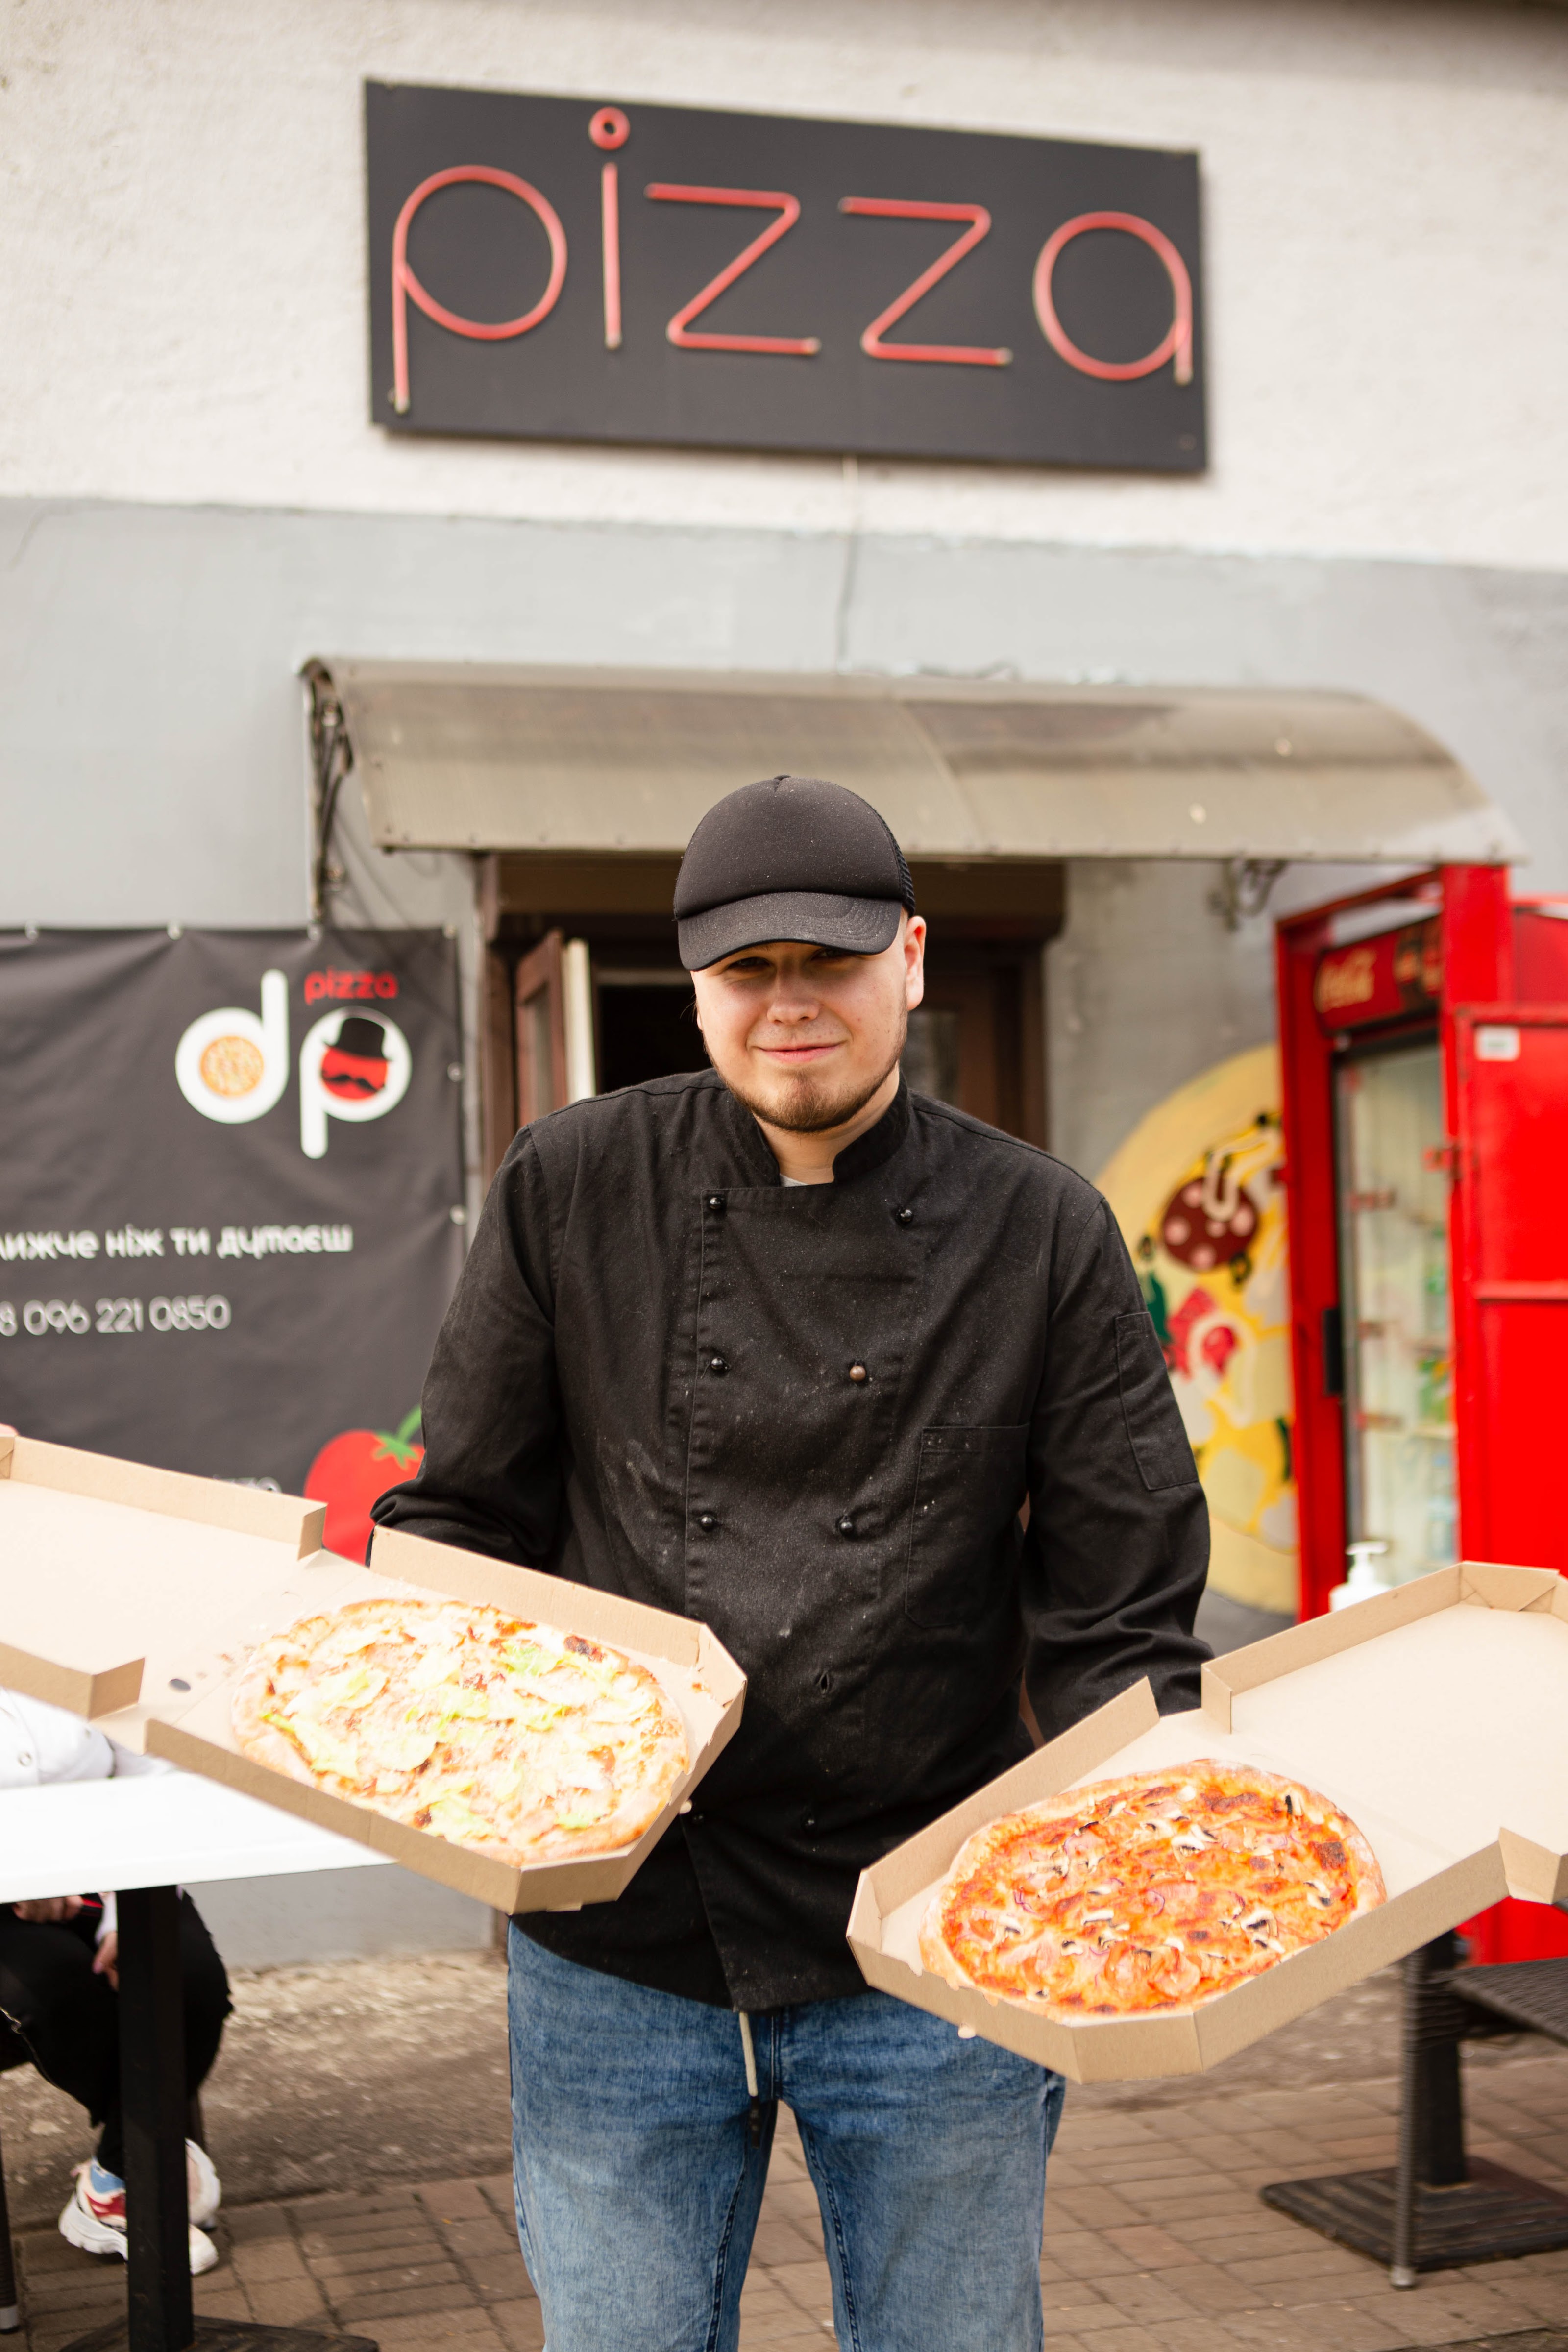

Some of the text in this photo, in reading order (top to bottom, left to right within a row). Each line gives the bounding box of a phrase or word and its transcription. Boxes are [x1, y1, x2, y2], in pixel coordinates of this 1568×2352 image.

[392, 106, 1193, 414] pizza
[304, 966, 399, 1005] pizza
[105, 1223, 165, 1258] ніж
[169, 1227, 211, 1256] ти
[23, 1299, 91, 1335] 096
[95, 1297, 144, 1333] 221
[149, 1294, 231, 1331] 0850
